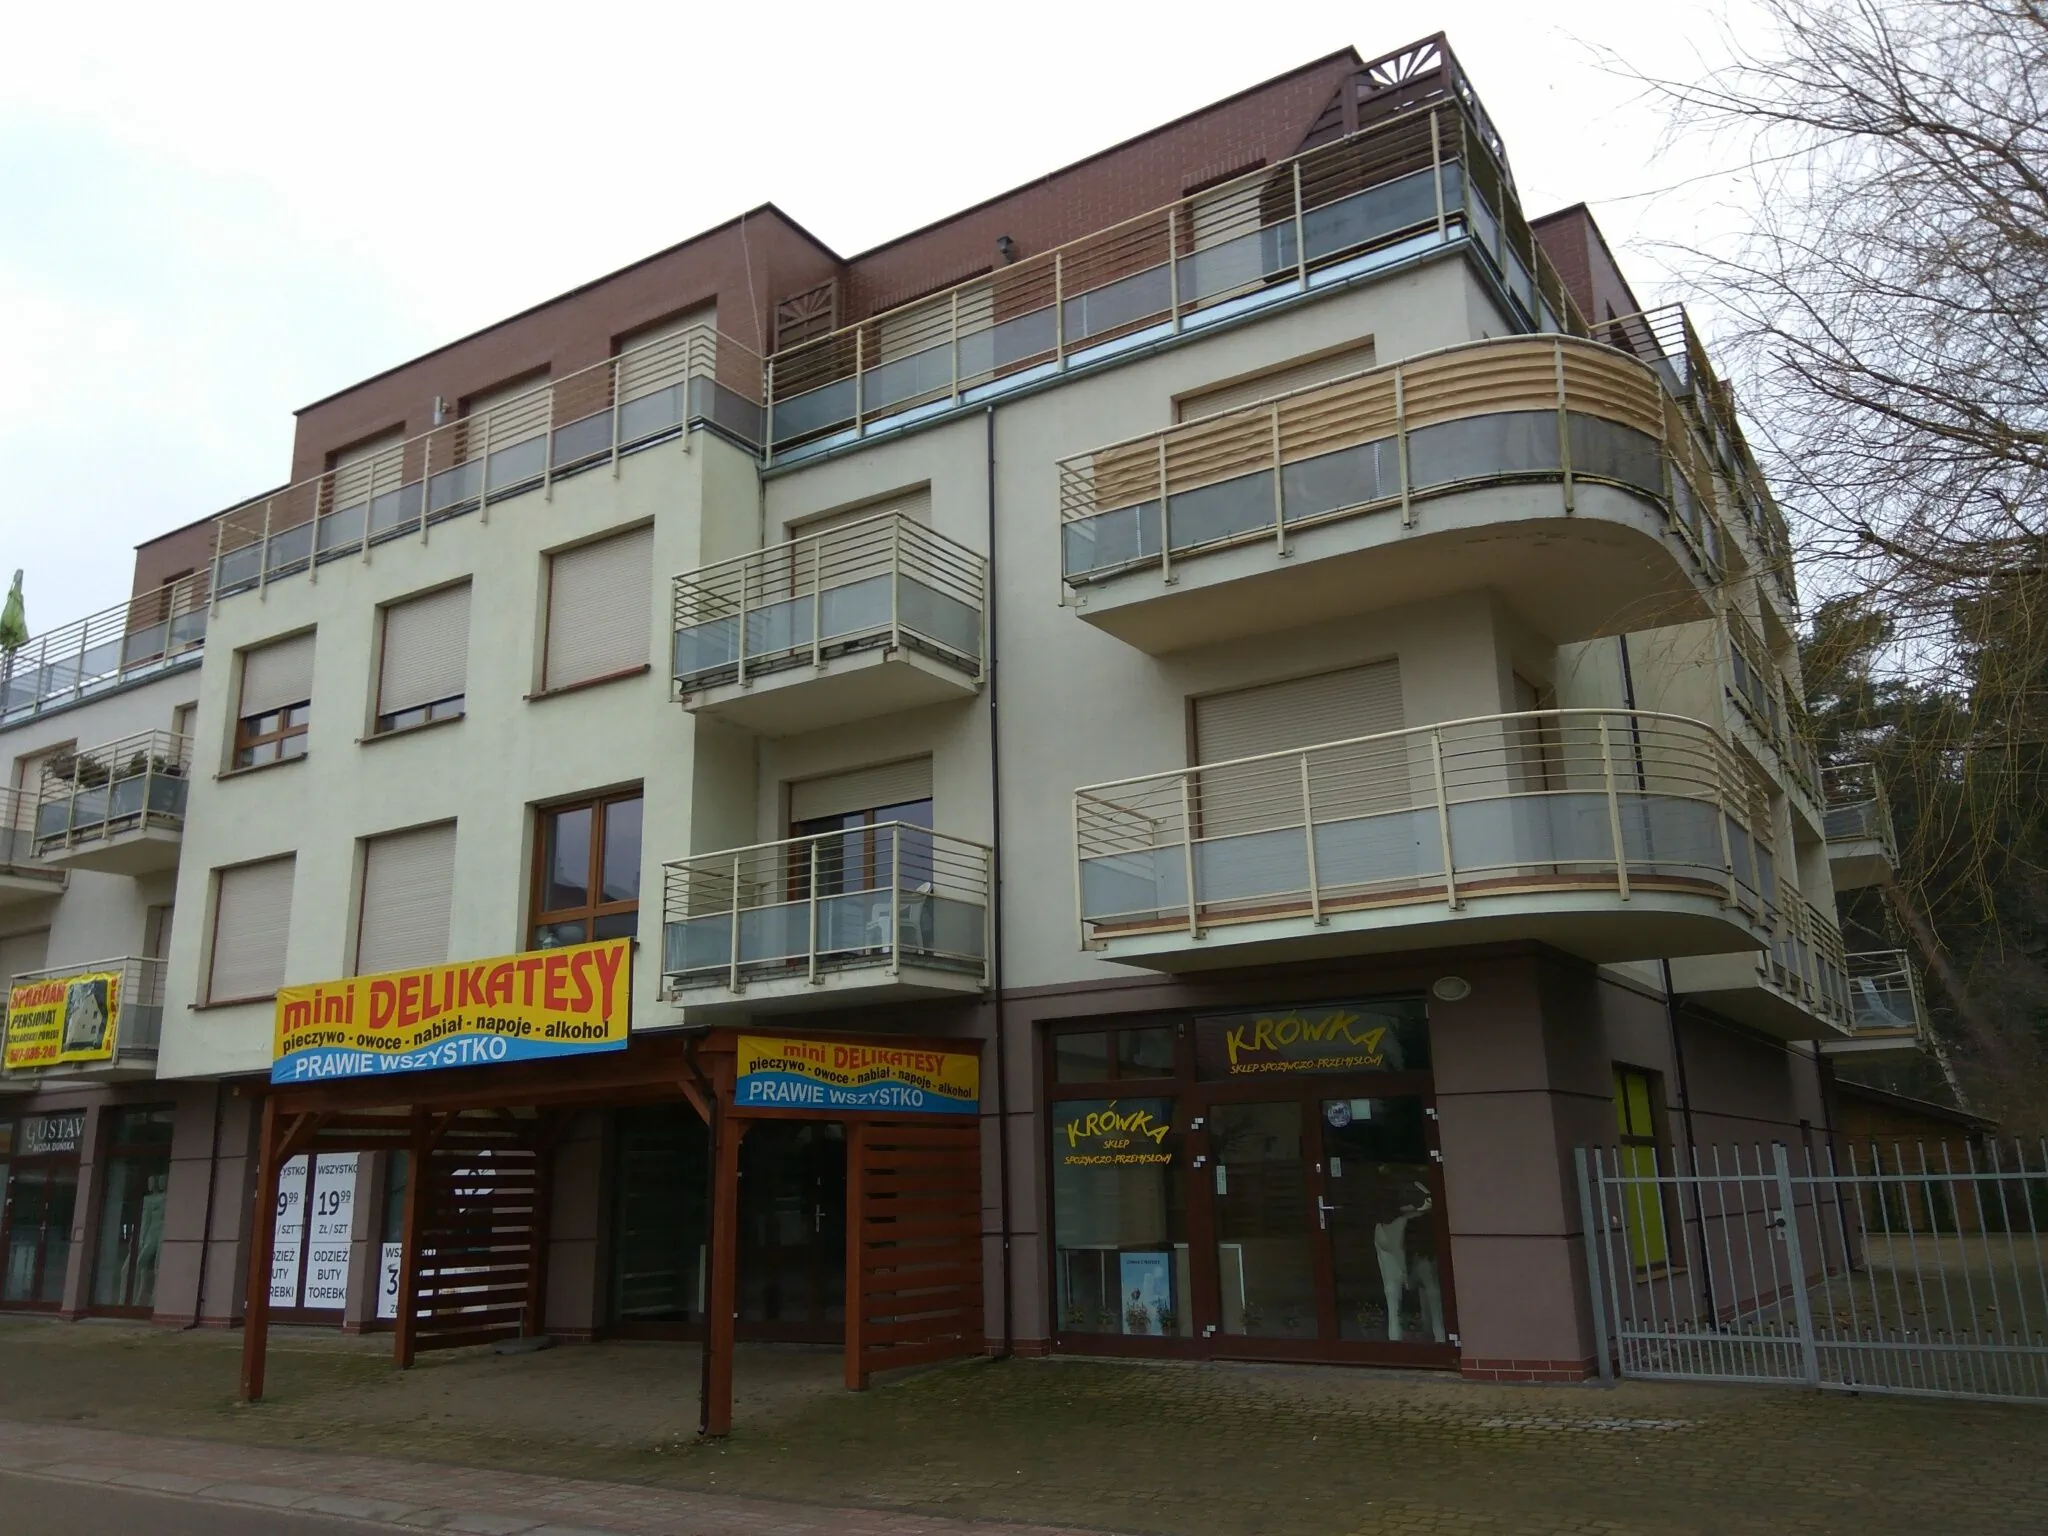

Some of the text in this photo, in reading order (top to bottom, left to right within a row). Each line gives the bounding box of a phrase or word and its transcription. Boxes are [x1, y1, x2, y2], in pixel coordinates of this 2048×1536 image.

[283, 945, 625, 1035] mini DELIKATESY
[282, 1031, 345, 1055] pieczywo
[356, 1033, 402, 1050] owoce
[413, 1015, 463, 1046] nabiał
[476, 1016, 532, 1037] napoje
[544, 1021, 609, 1038] alkohol
[1226, 1009, 1386, 1065] KRÓWKA
[295, 1036, 507, 1079] PRAWIE WSZYSTKO
[783, 1043, 946, 1077] mini DELIKATESY
[1230, 1064, 1260, 1075] SKLEP
[748, 1081, 924, 1107] PRAWIE WSZYSTKO
[749, 1056, 805, 1073] pieczywo
[814, 1067, 849, 1084] owoce
[857, 1068, 891, 1084] nabiał
[898, 1070, 931, 1089] napoje
[938, 1082, 972, 1098] alkohol
[26, 1117, 86, 1144] GUSTAV
[1067, 1100, 1170, 1148] KRÓWKA
[1103, 1139, 1130, 1149] SKLEP
[314, 1247, 348, 1262] ODZIEŻ
[317, 1269, 342, 1280] BUTY
